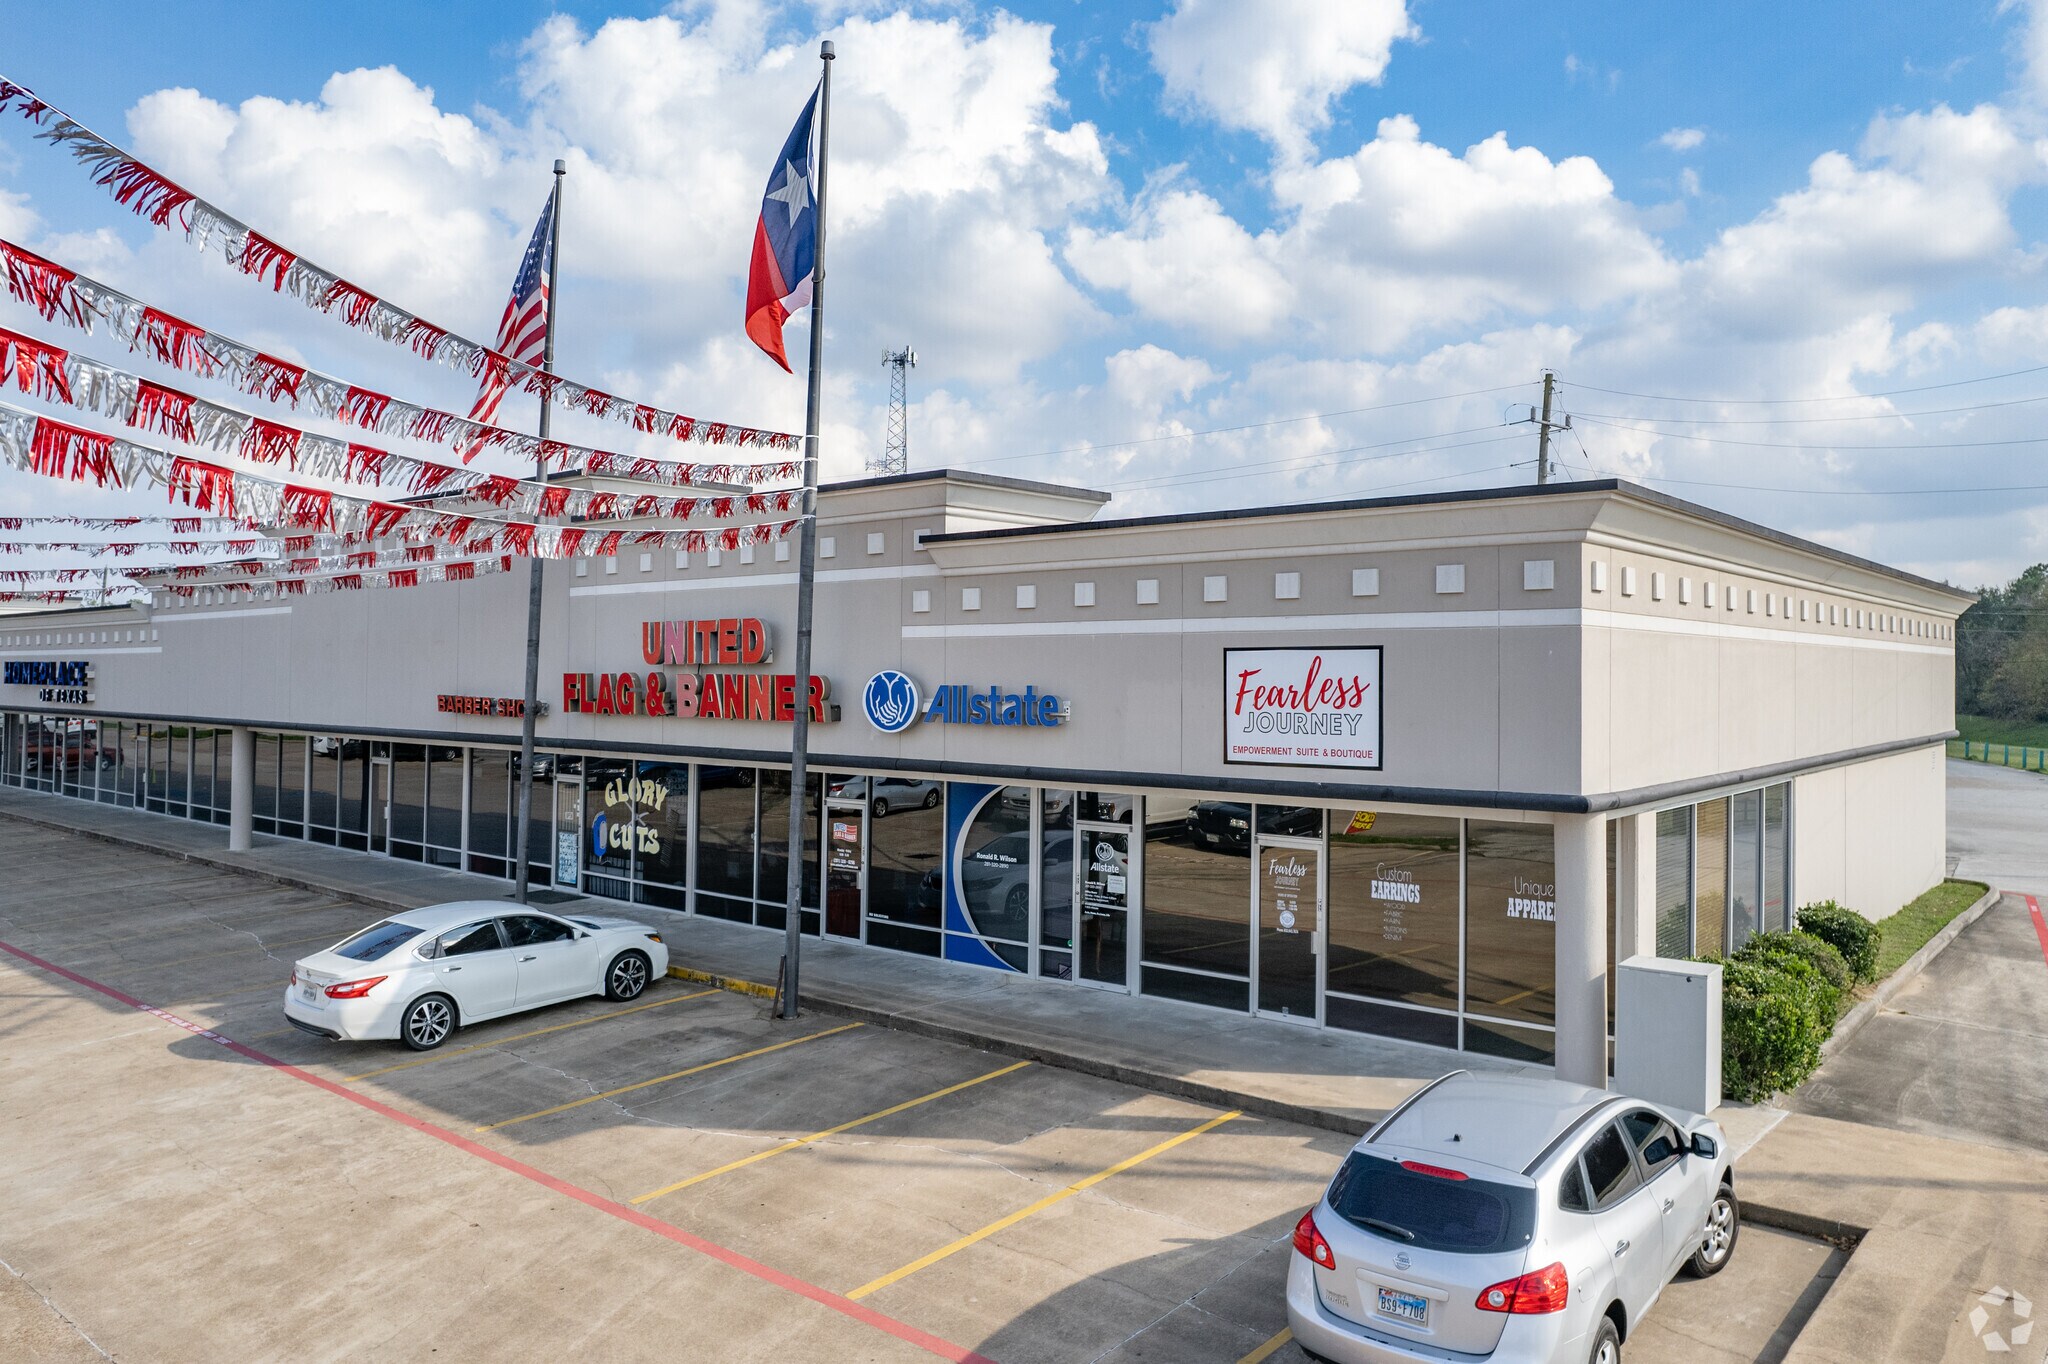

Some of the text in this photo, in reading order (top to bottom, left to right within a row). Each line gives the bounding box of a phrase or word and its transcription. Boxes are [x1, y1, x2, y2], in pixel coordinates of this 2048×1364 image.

[642, 618, 769, 664] UNITED
[4, 661, 88, 686] HOMEPLACE
[40, 689, 85, 704] OF TEXAS
[563, 671, 829, 723] FLAG & BANNER
[1235, 656, 1370, 715] Fearless
[438, 695, 526, 718] BARBER SHO
[924, 685, 1061, 727] Allstate
[1243, 712, 1362, 736] JOURNEY
[1233, 746, 1373, 759] EMPOWERMENT SUITE & BOUTIQUE
[605, 777, 669, 811] GLORY
[609, 823, 660, 854] CUTS
[976, 852, 993, 860] Ronald
[1000, 855, 1017, 863] Wilson
[1090, 862, 1119, 873] Allstate
[1269, 857, 1307, 876] Fearless
[1377, 863, 1412, 882] Custom
[1371, 880, 1420, 903] EARRINGS
[1514, 876, 1554, 899] Unique
[1381, 1297, 1425, 1320] BS9 F708
